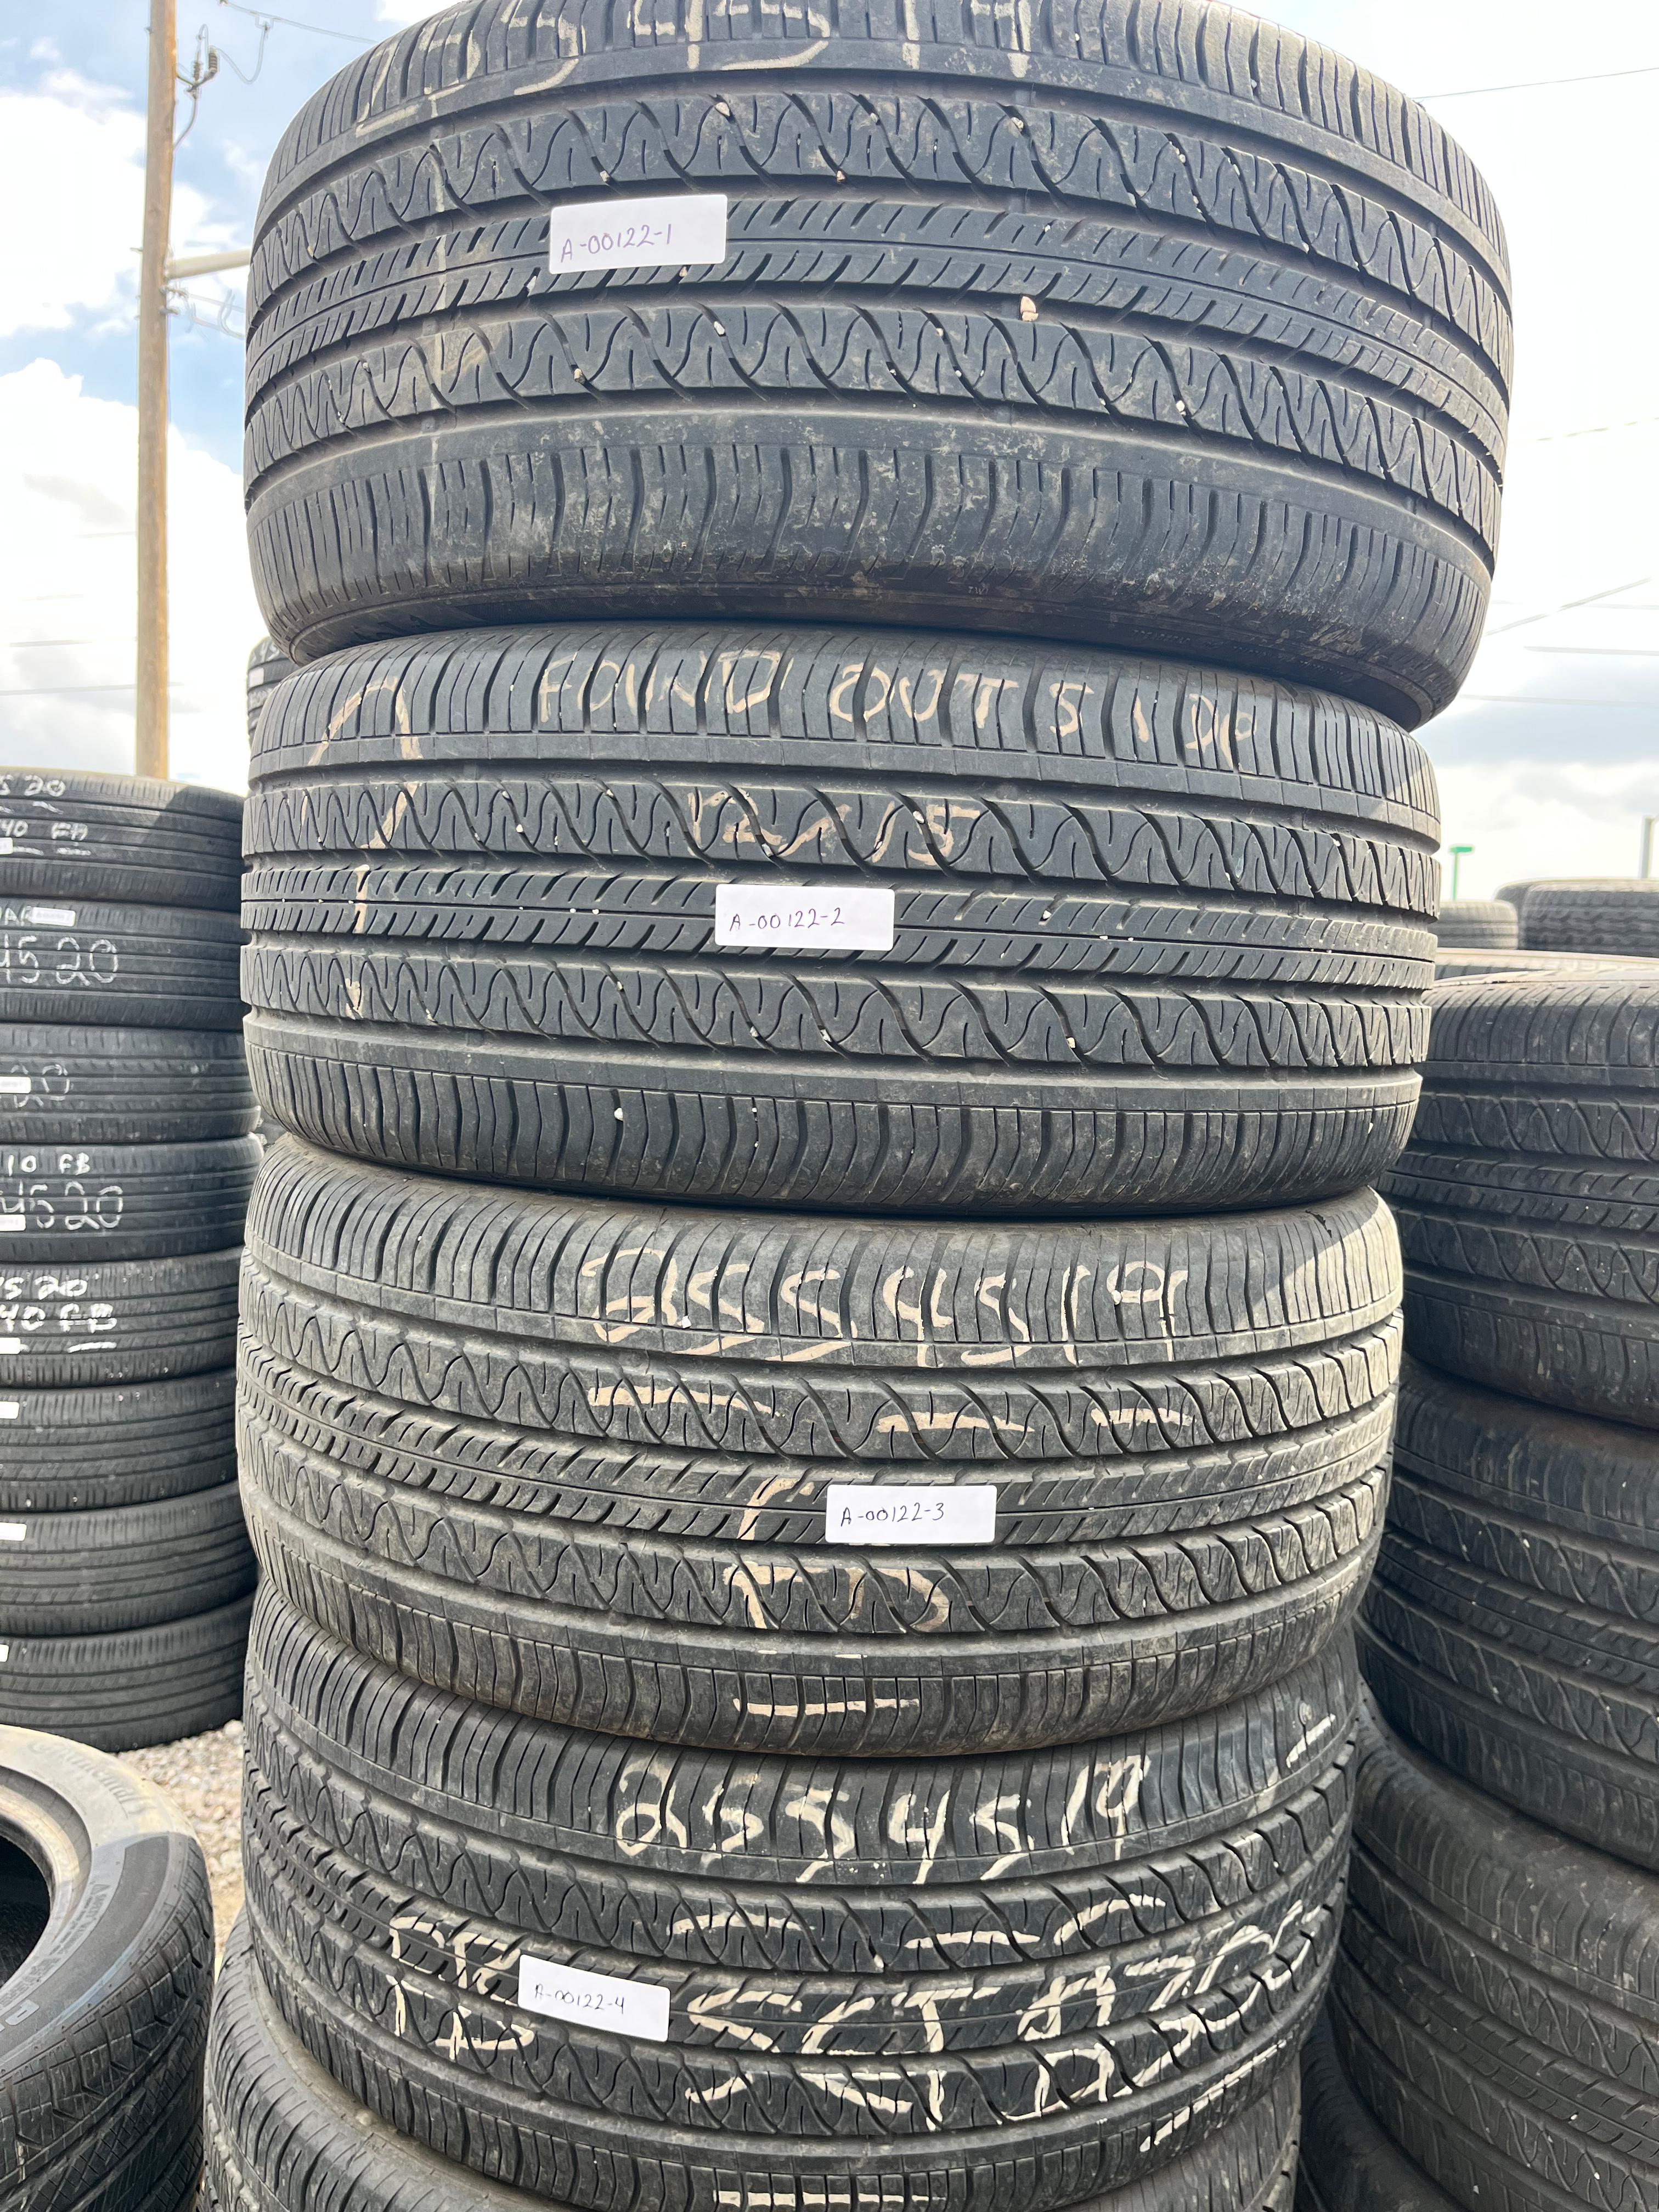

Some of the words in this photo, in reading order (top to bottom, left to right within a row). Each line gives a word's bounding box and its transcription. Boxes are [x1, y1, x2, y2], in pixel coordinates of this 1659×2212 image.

[561, 223, 672, 263] A-00122-1
[830, 662, 1019, 729] OUT
[24, 774, 66, 797] 20
[729, 907, 845, 932] A-00122-2
[55, 936, 119, 986] 20
[59, 1152, 91, 1176] FB
[64, 1180, 124, 1231] 20
[0, 1276, 25, 1300] 5
[33, 1275, 88, 1300] 20
[59, 1302, 118, 1334] FB
[580, 1246, 859, 1363] 255
[882, 1265, 1033, 1369] 45
[839, 1502, 944, 1527] A-00122-3
[615, 1757, 856, 1883] 255
[888, 1789, 1035, 1885] 45
[534, 1983, 627, 2015] A-00122-4
